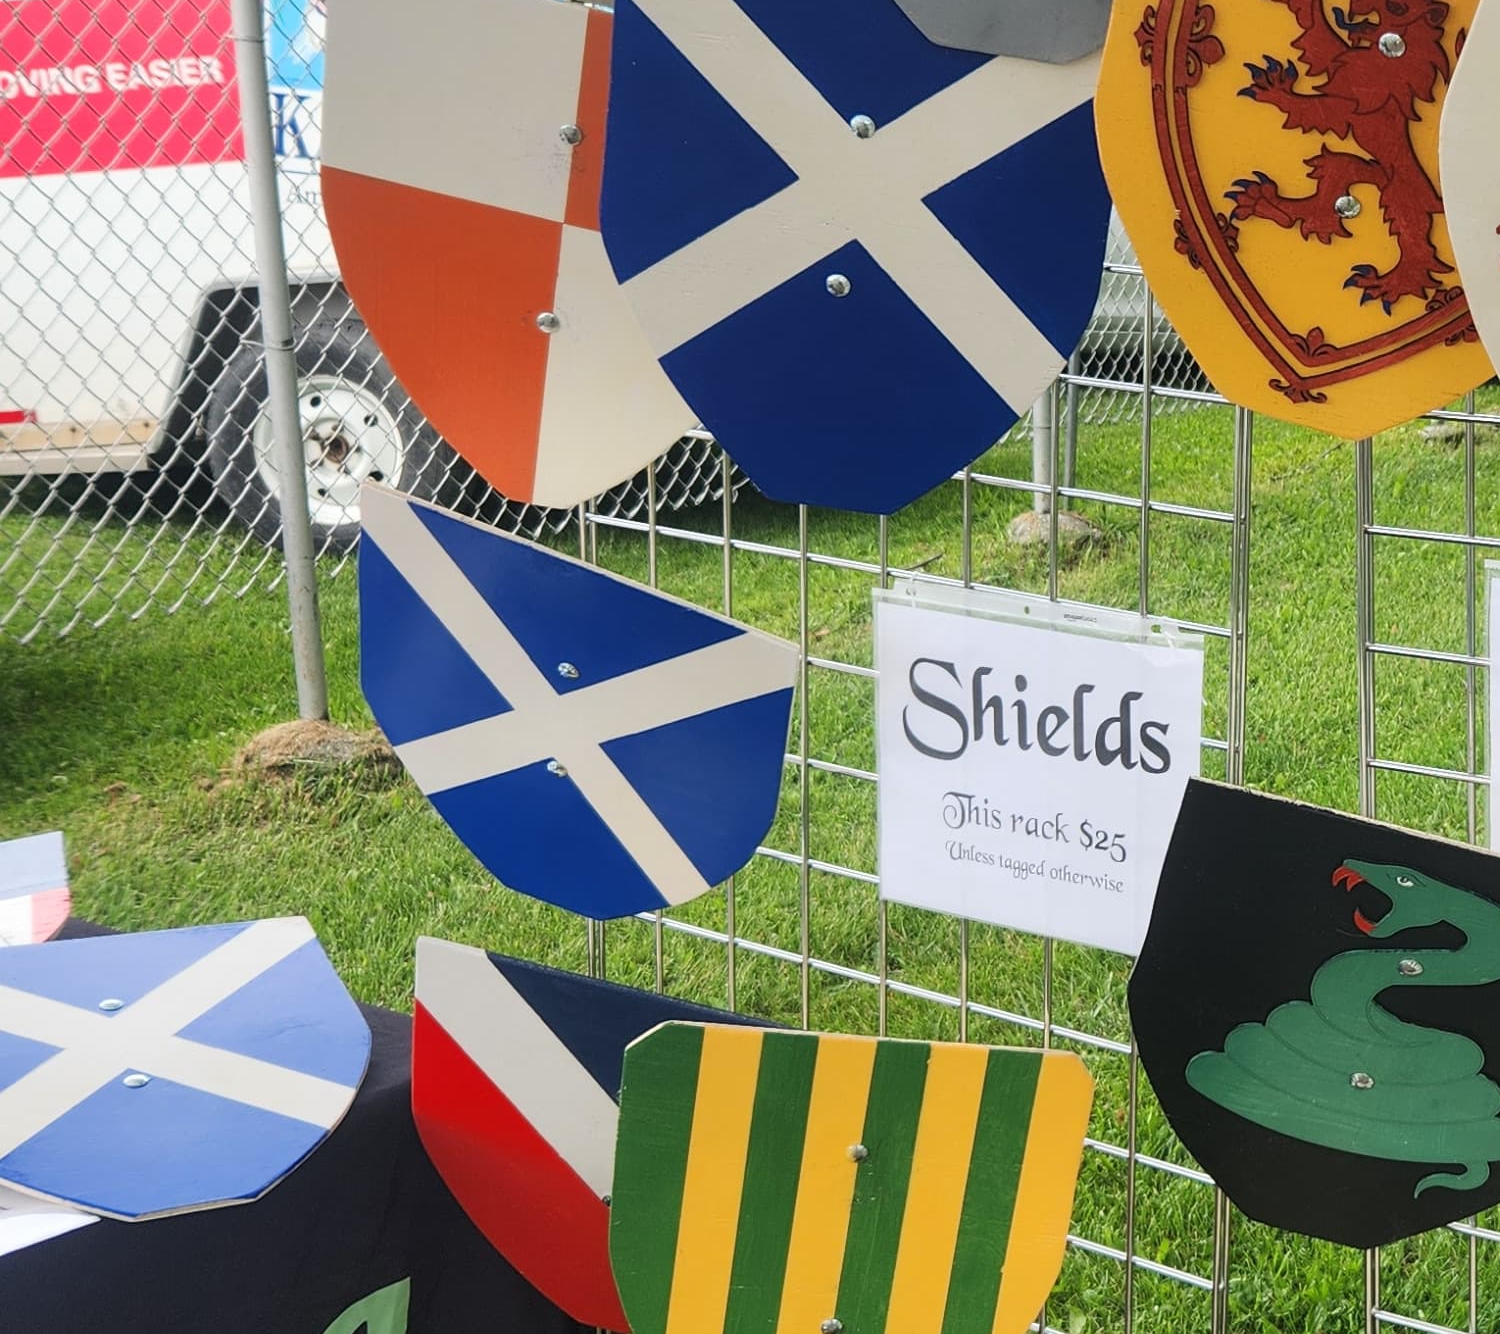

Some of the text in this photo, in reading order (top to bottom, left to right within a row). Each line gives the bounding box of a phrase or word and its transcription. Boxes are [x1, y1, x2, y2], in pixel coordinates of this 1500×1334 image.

[106, 55, 225, 91] EASIER
[902, 657, 1171, 774] Shields
[942, 791, 1127, 863] This rack $25
[945, 840, 1124, 893] Unless tagged otherwise
